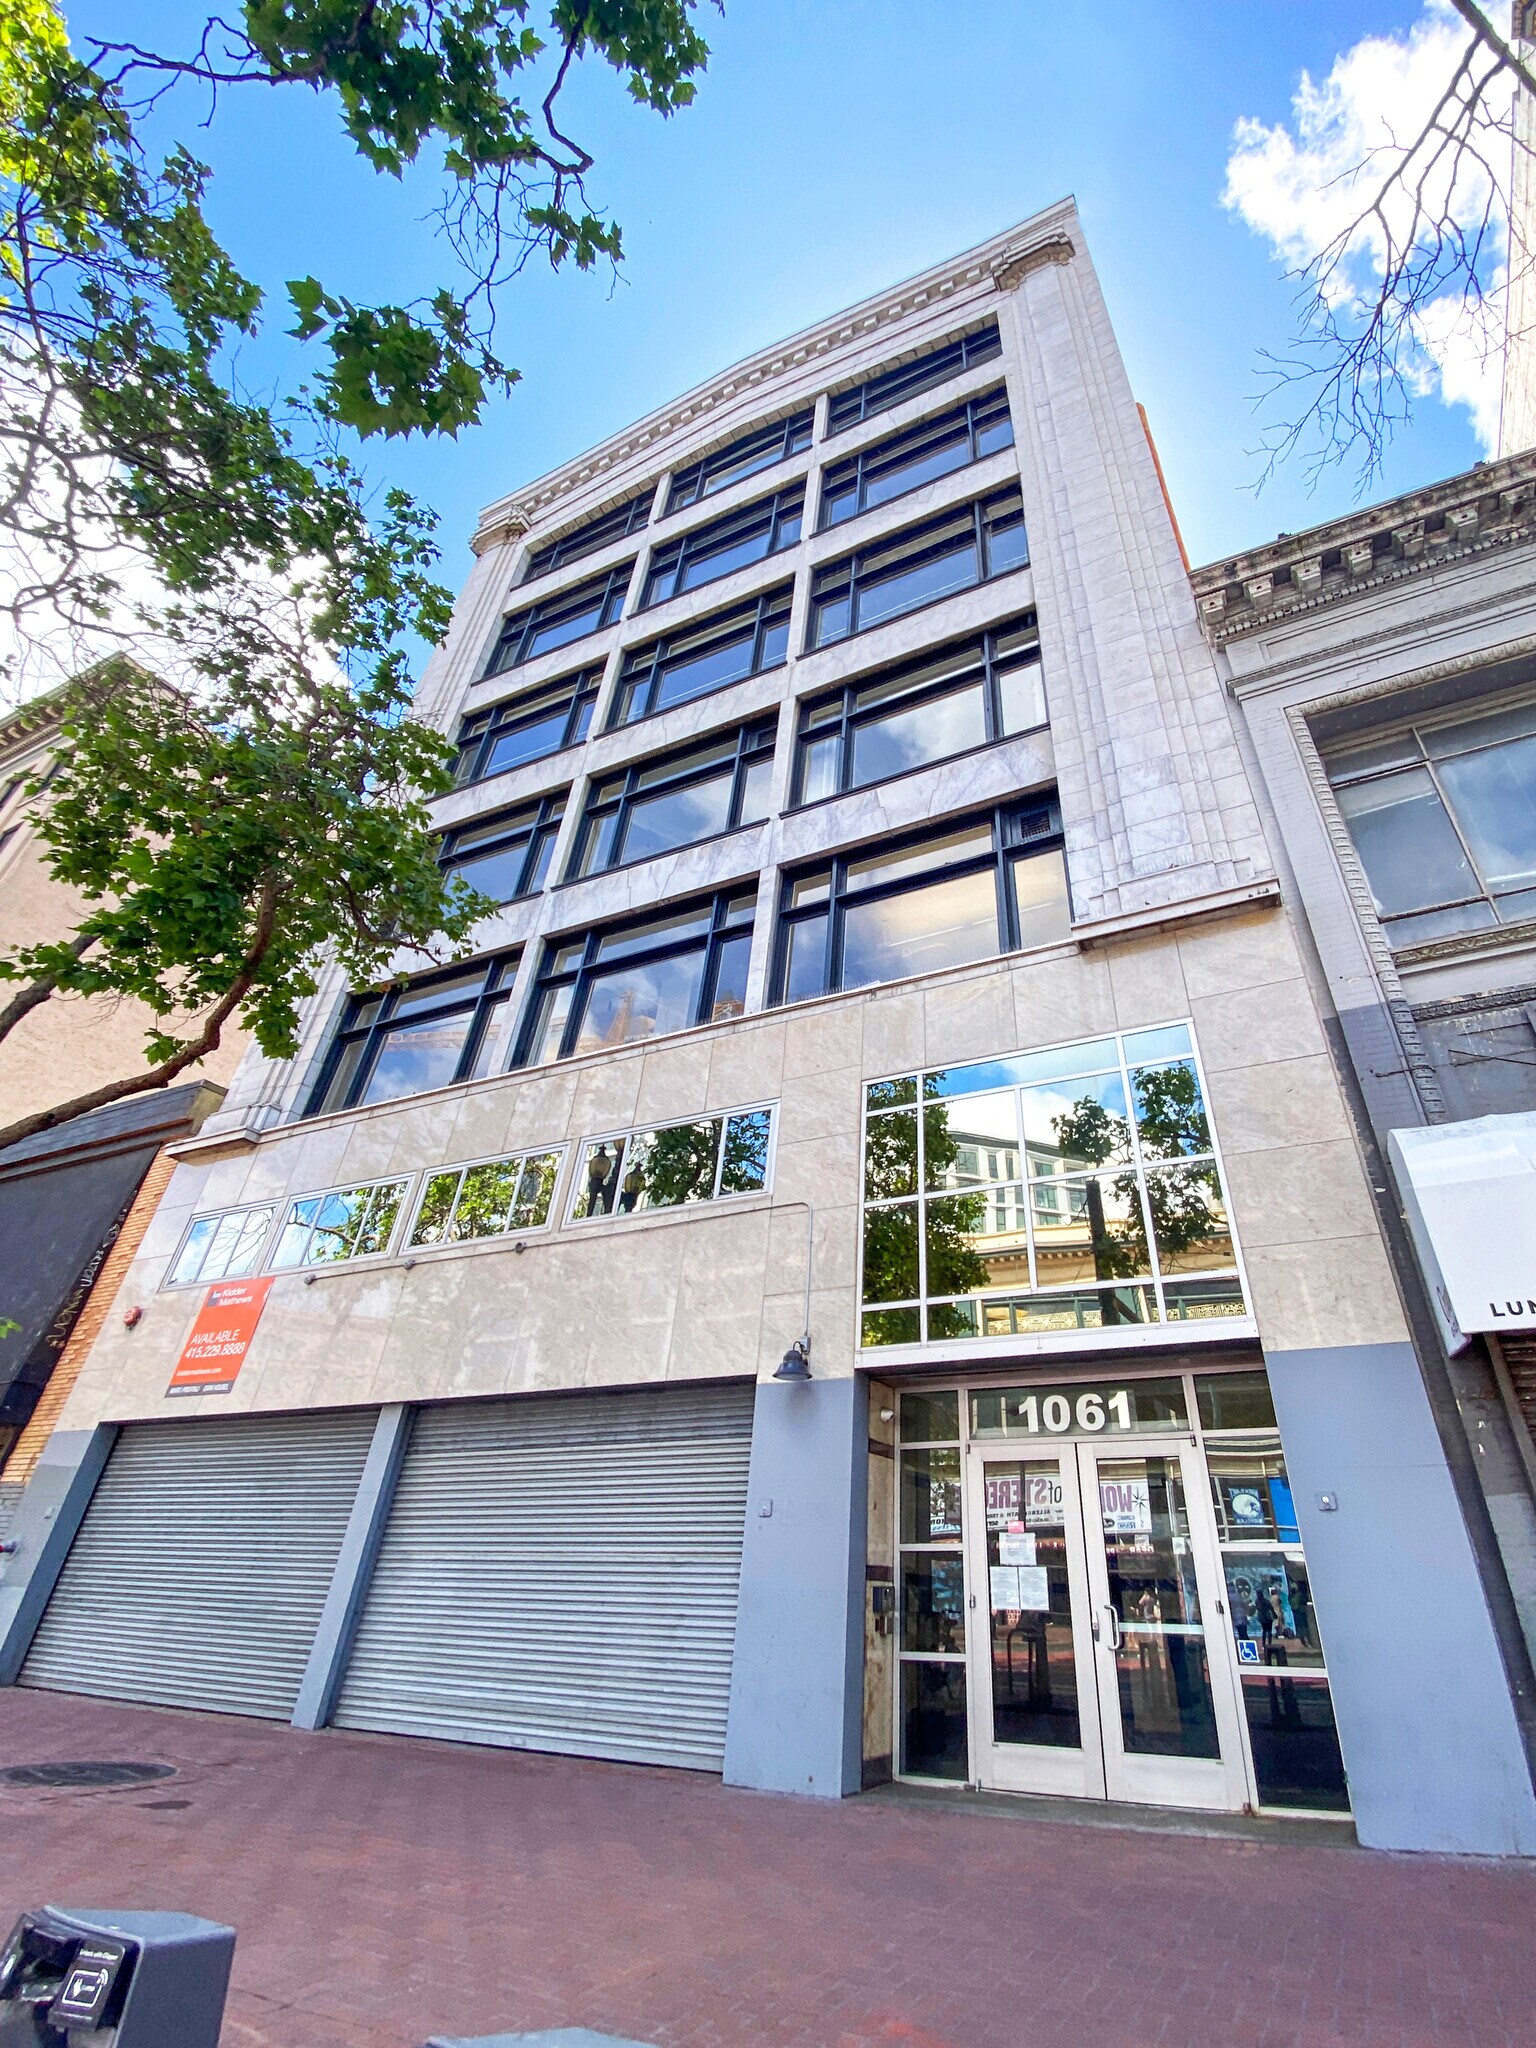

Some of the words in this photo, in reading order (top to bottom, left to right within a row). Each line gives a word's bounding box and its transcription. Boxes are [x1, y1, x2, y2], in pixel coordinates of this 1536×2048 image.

[222, 1287, 248, 1297] Kidder
[218, 1295, 254, 1306] Mathews
[191, 1330, 240, 1344] AVAILABLE
[185, 1342, 246, 1358] 415.229.8888
[1018, 1391, 1131, 1433] 1061
